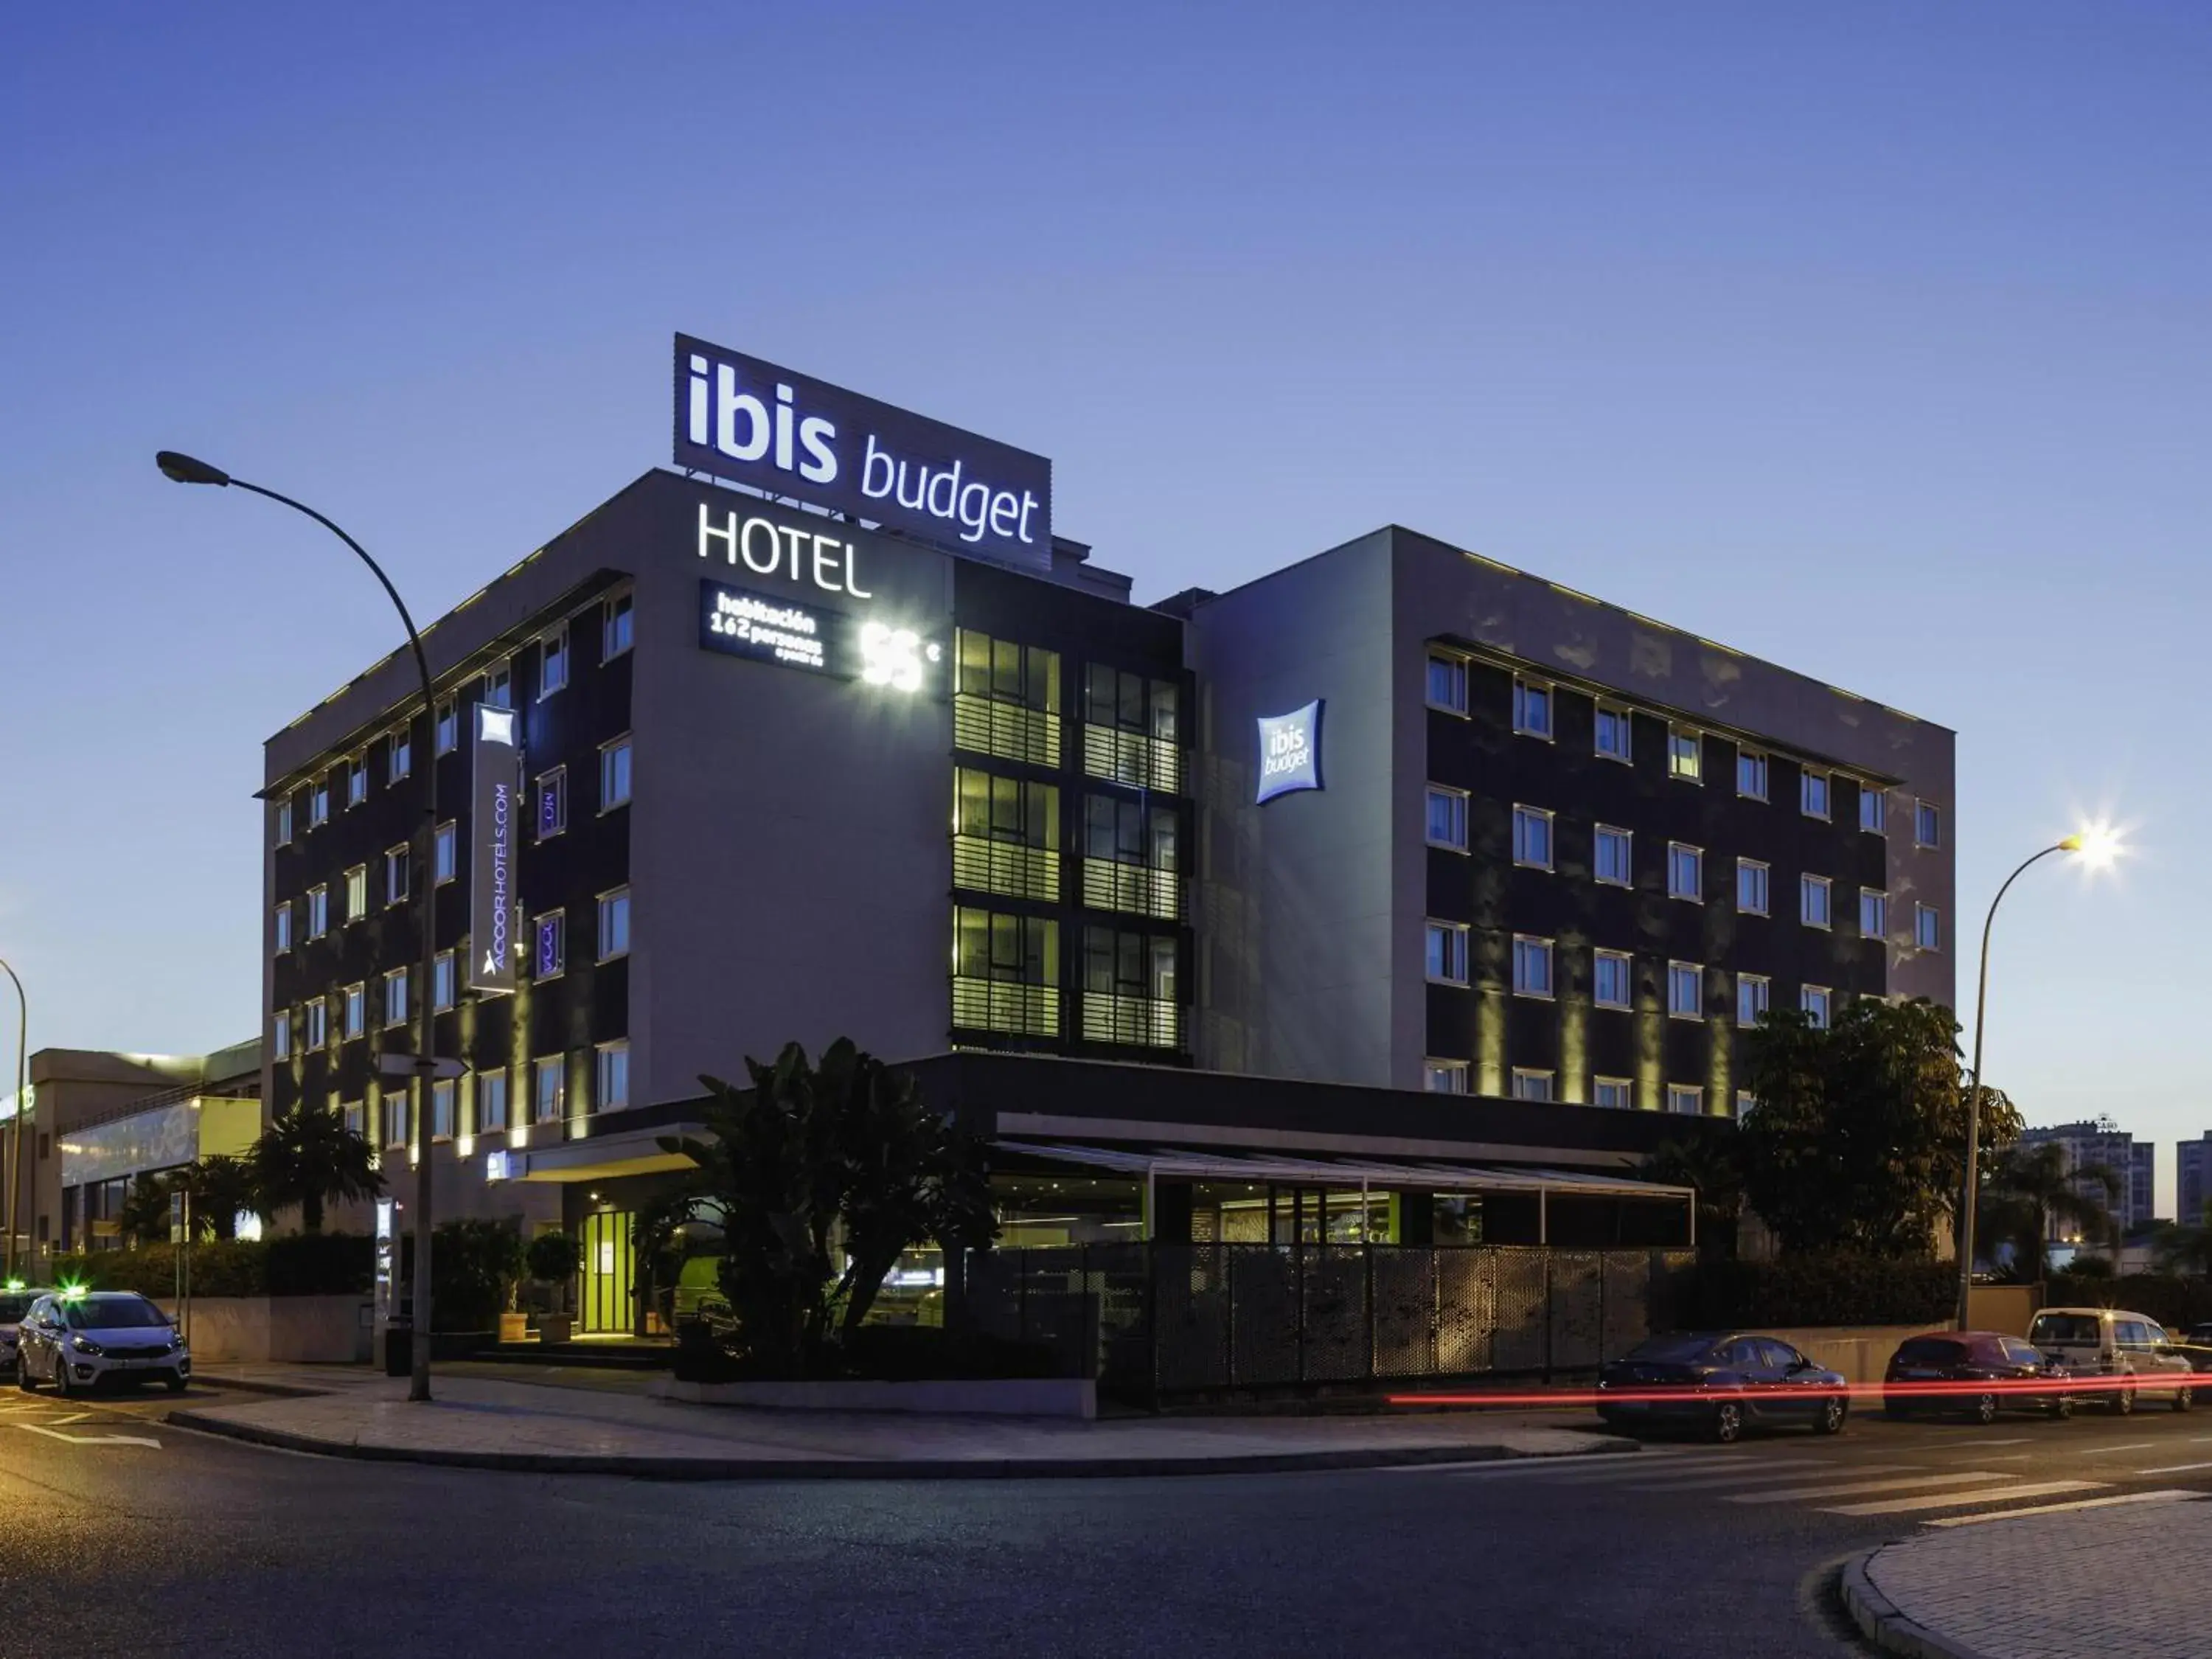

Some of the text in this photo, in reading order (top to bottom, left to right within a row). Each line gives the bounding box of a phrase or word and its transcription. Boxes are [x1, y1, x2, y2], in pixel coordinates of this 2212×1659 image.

[689, 354, 1039, 543] ibis budget
[699, 504, 872, 598] HOTEL
[711, 612, 723, 633] 1
[737, 618, 750, 639] 2
[1265, 746, 1310, 776] budget
[1270, 724, 1305, 757] ibis
[493, 784, 508, 970] ACCORHOTELS.COM
